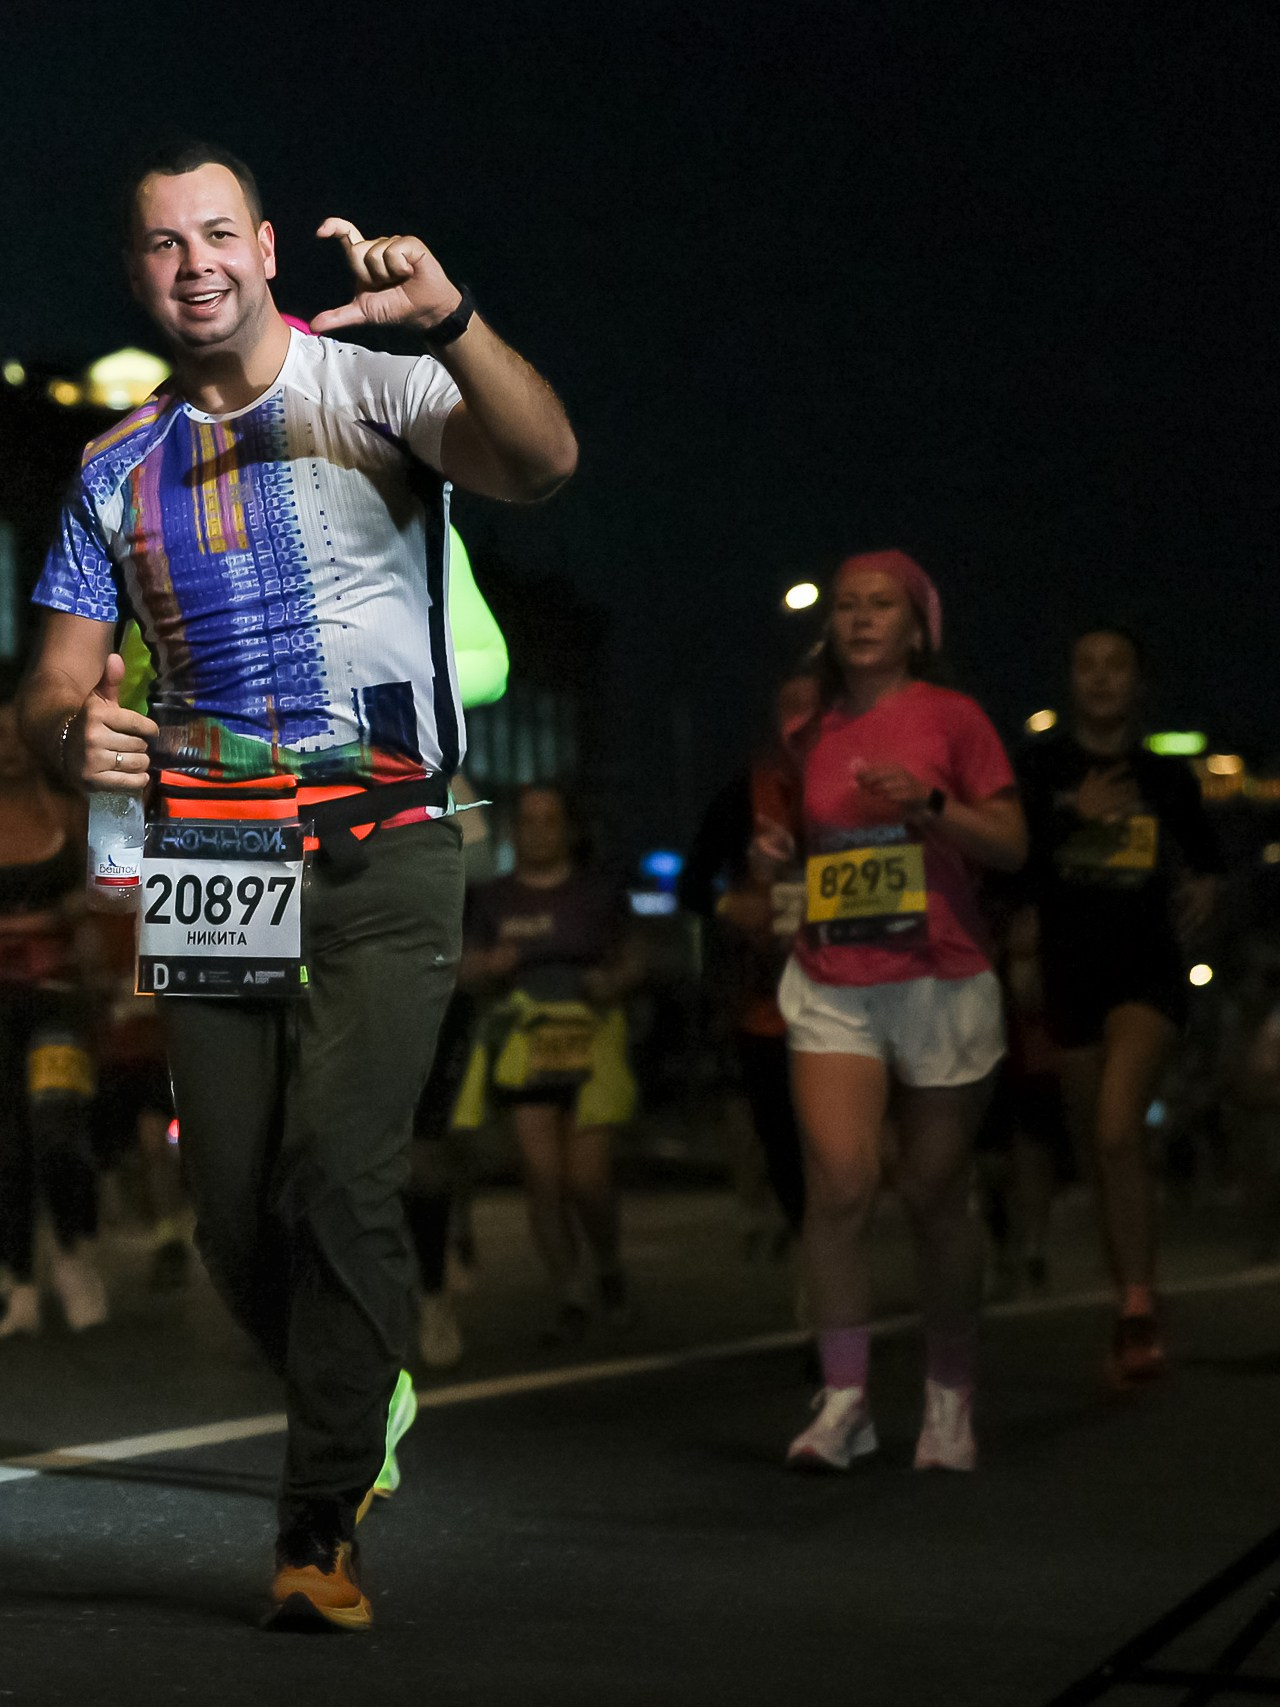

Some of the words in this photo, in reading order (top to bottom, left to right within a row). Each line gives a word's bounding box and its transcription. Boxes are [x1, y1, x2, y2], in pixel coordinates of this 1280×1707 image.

[820, 857, 908, 899] 8295
[144, 873, 297, 926] 20897
[186, 930, 248, 946] НИКИТА
[152, 962, 170, 990] D
